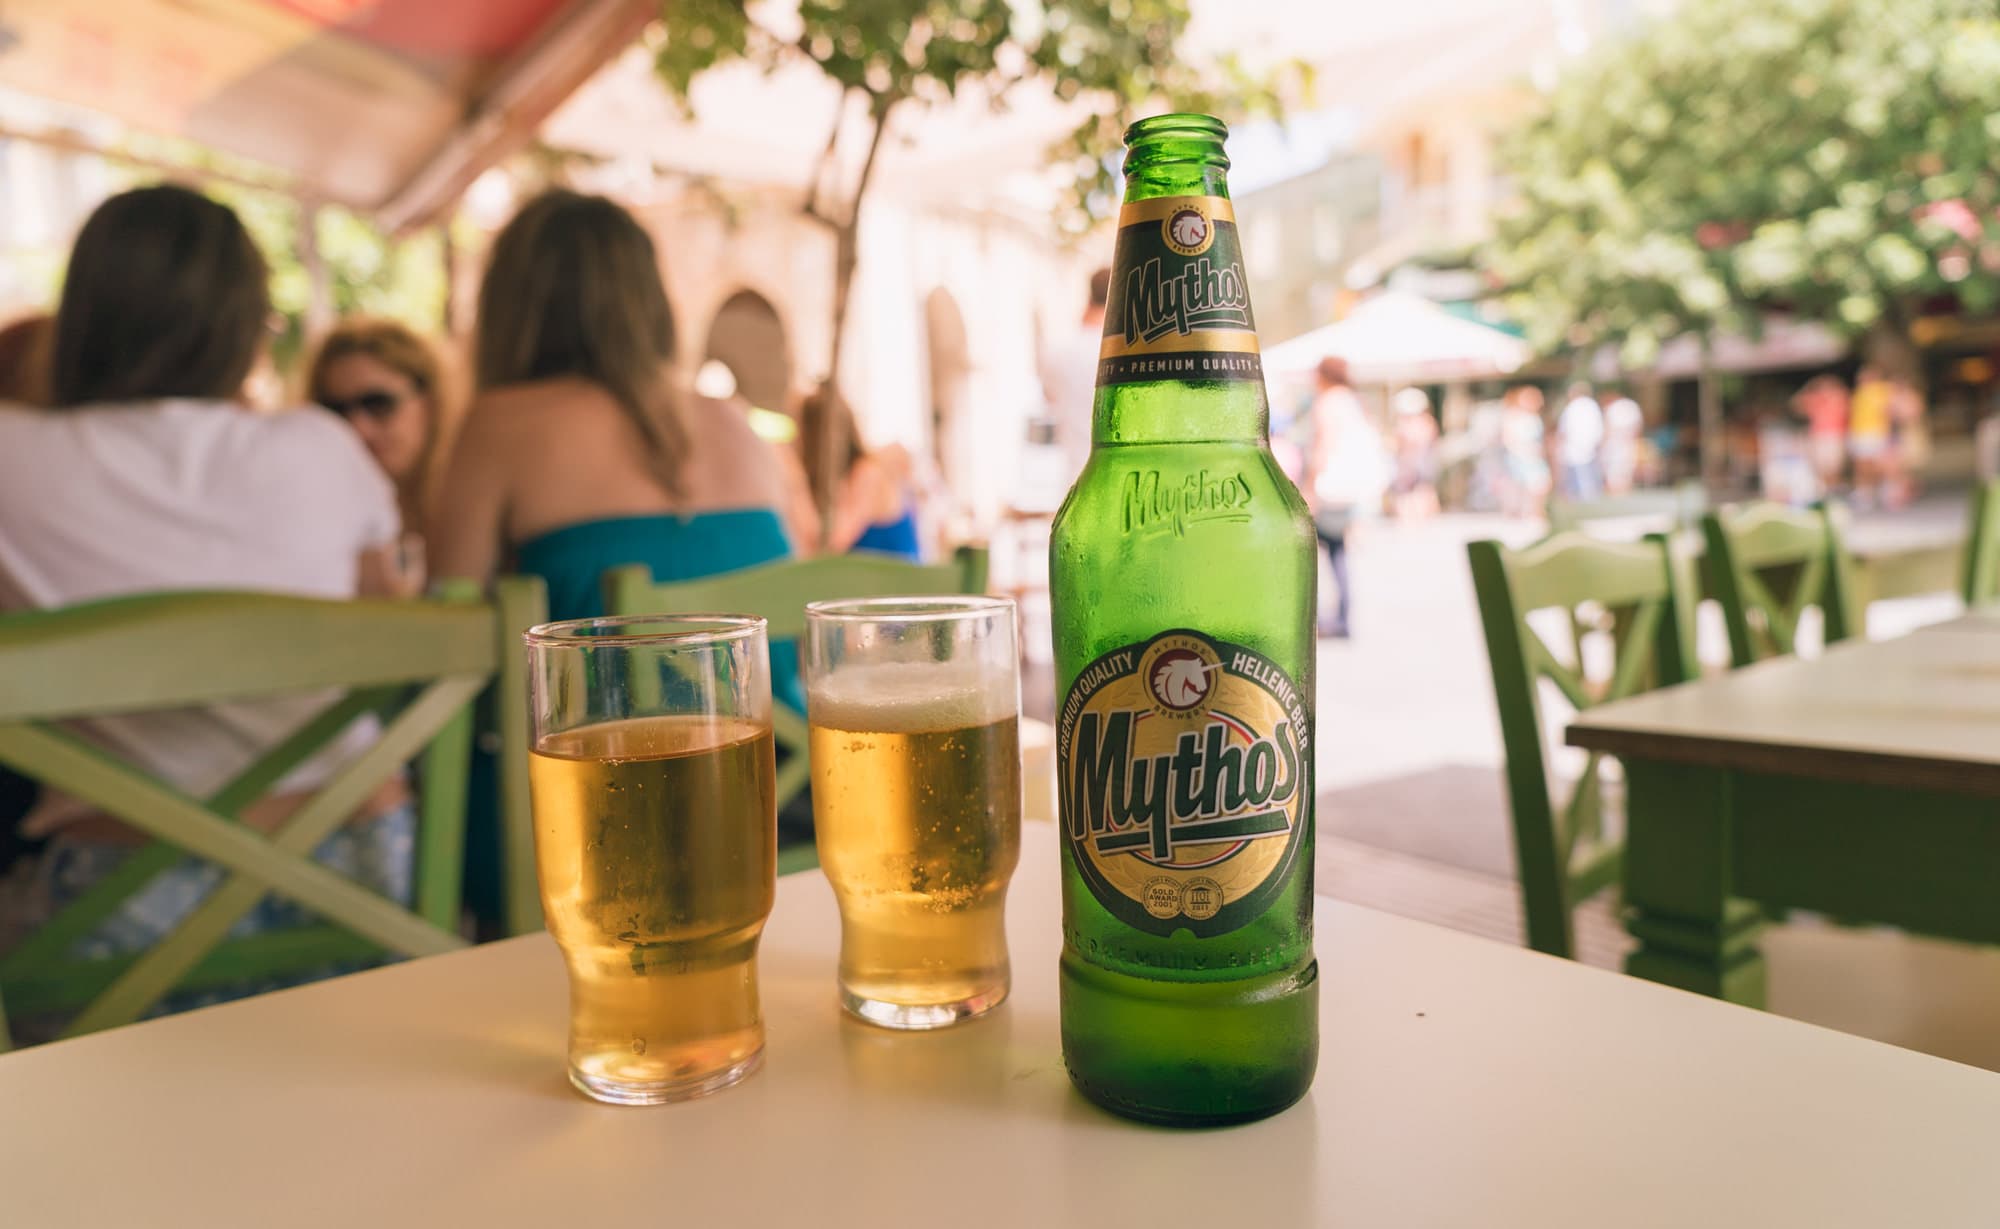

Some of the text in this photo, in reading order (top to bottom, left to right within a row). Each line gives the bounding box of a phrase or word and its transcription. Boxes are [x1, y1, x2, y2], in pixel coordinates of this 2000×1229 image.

[1125, 257, 1248, 347] Mythos
[1131, 359, 1194, 374] PREMIUM
[1202, 358, 1251, 371] QUALITY
[1120, 469, 1253, 538] Mythos
[1153, 639, 1206, 655] MYTHOS
[1060, 651, 1133, 759] PREMIUM QUALITY
[1154, 703, 1206, 720] BREWERY
[1231, 652, 1308, 752] HELLENIC BEER
[1073, 709, 1300, 862] Mythos
[1149, 894, 1178, 902] AWARD
[1152, 888, 1174, 896] GOLD
